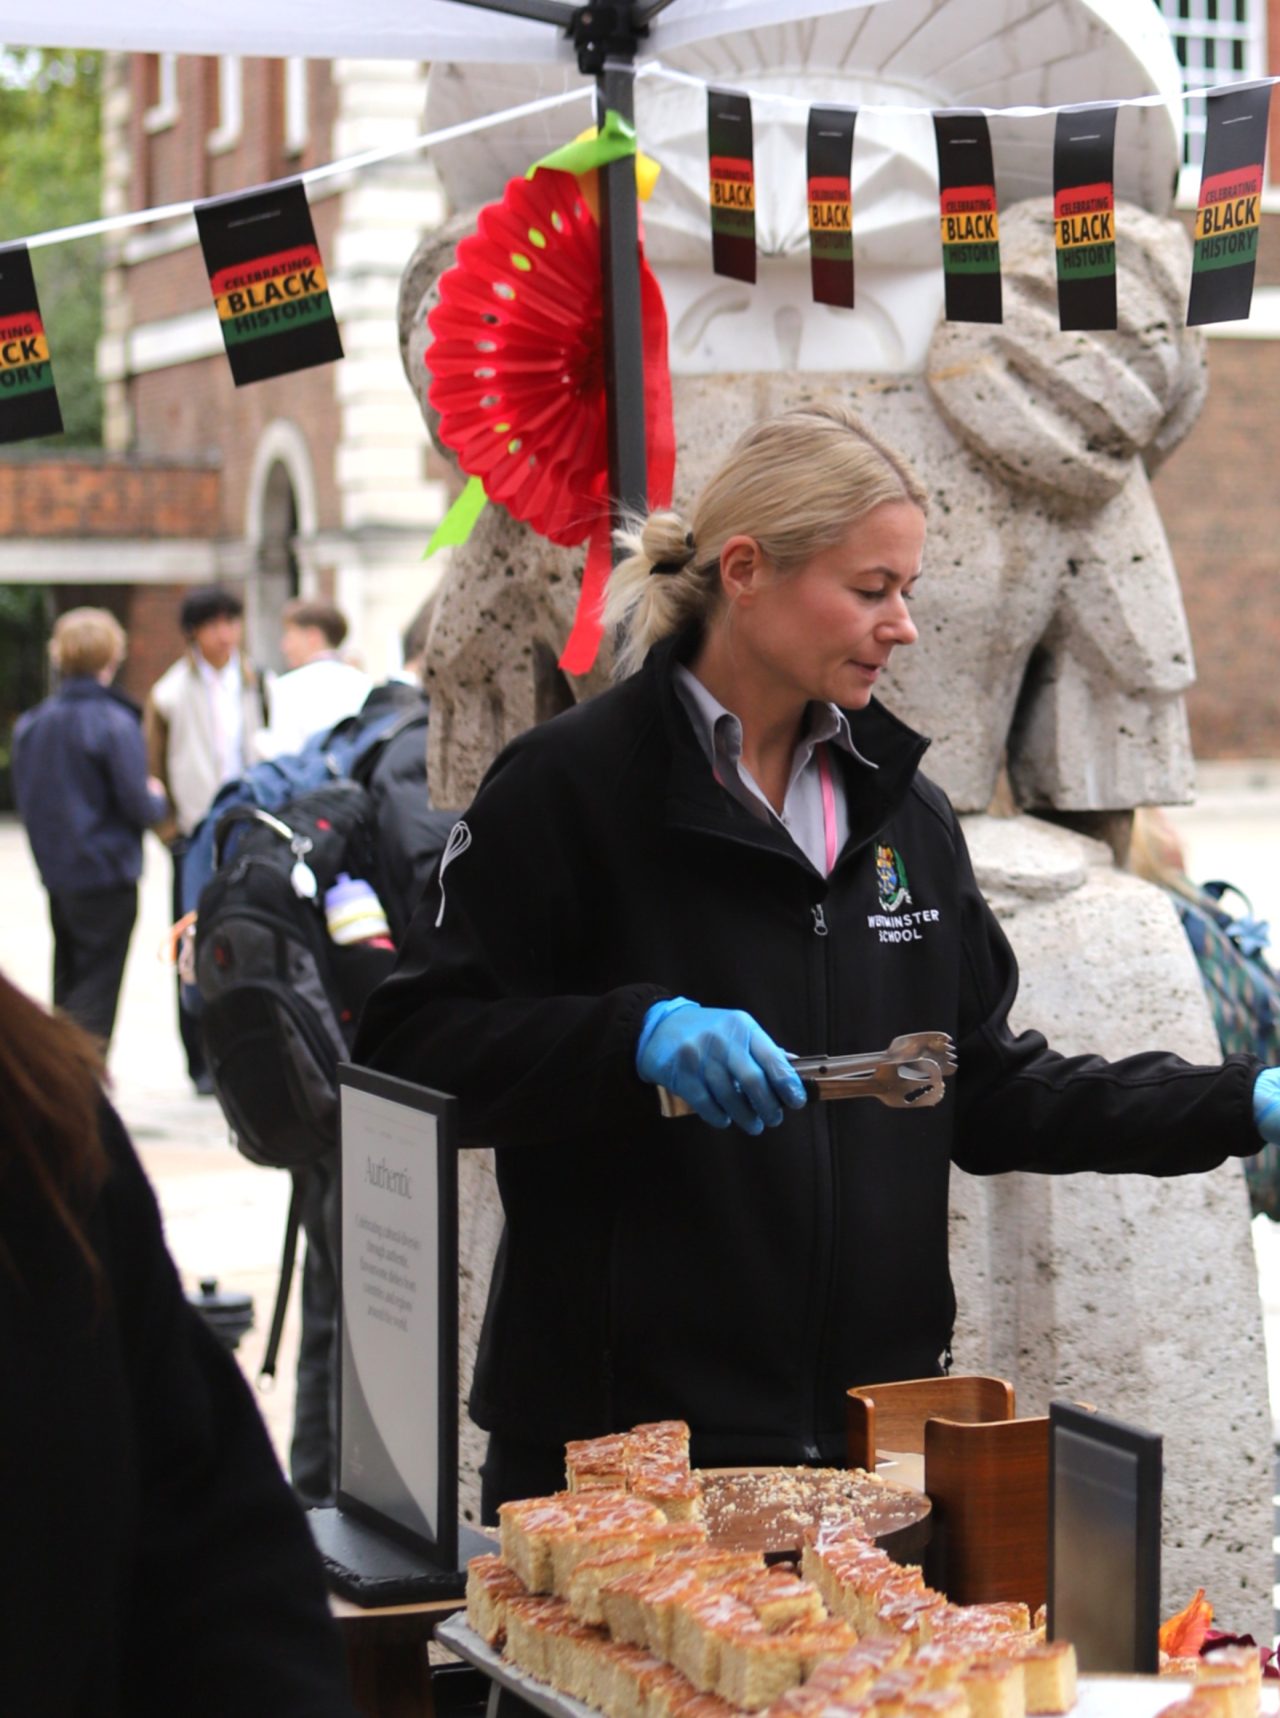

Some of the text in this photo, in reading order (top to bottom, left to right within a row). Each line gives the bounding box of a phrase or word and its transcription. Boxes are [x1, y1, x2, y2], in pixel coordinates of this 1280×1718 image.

[714, 183, 753, 208] BLACK
[1205, 182, 1257, 203] CELEBRATING
[812, 204, 849, 227] BLACK
[946, 214, 995, 240] BLACK
[1061, 213, 1111, 245] BLACK
[1203, 196, 1257, 235] BLACK
[1063, 247, 1112, 269] HISTORY
[1201, 230, 1254, 261] HISTORY
[224, 257, 313, 290] CELEBRATING
[230, 270, 320, 314] BLACK
[234, 295, 324, 334] HISTORY
[879, 928, 922, 943] SCHOOL
[364, 1155, 412, 1200] Authentic
